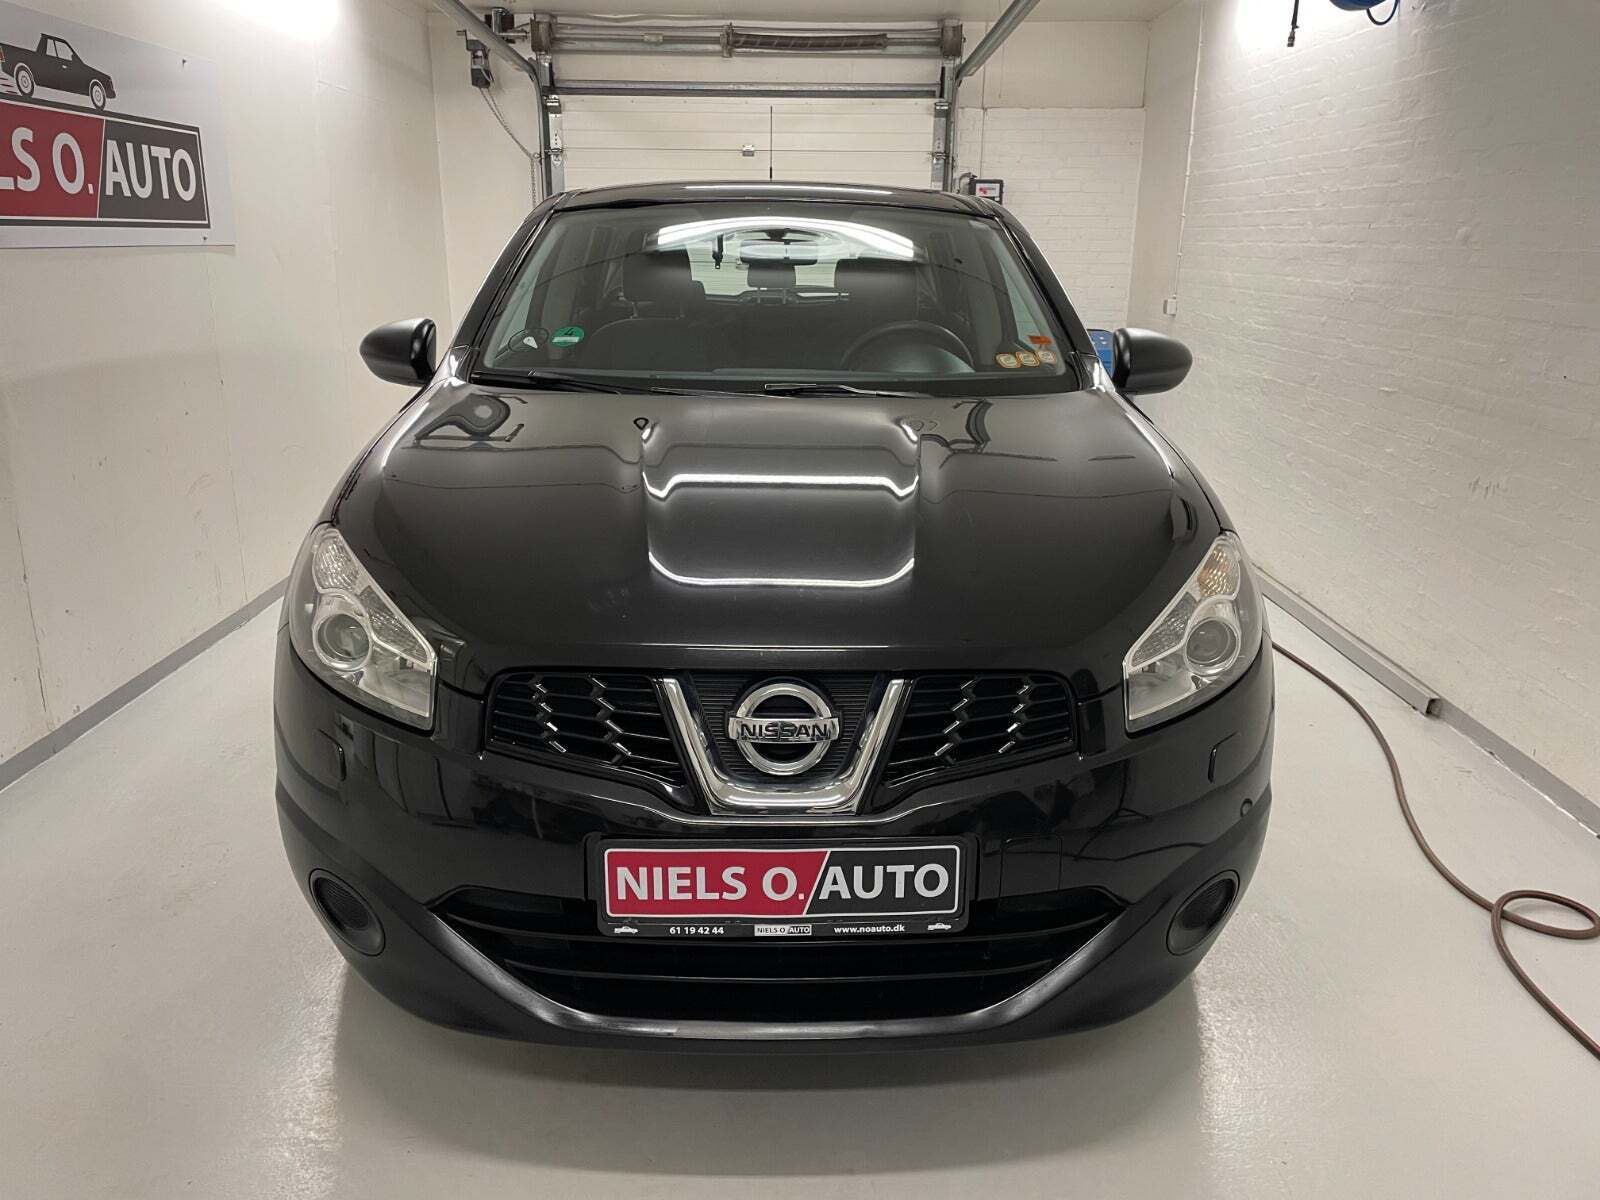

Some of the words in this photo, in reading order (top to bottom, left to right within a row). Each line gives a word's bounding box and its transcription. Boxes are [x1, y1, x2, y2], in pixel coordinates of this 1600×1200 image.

[52, 132, 94, 195] O.
[105, 139, 197, 201] AUTO
[740, 721, 828, 738] NISSAN
[615, 866, 748, 901] NIELS
[762, 866, 805, 902] O.
[818, 863, 949, 899] AUTO
[669, 926, 681, 935] 61
[684, 926, 696, 935] 19
[698, 926, 710, 935] 42
[711, 926, 724, 935] 44
[789, 926, 810, 934] AUTO
[833, 924, 905, 934] www.noauto.dk
